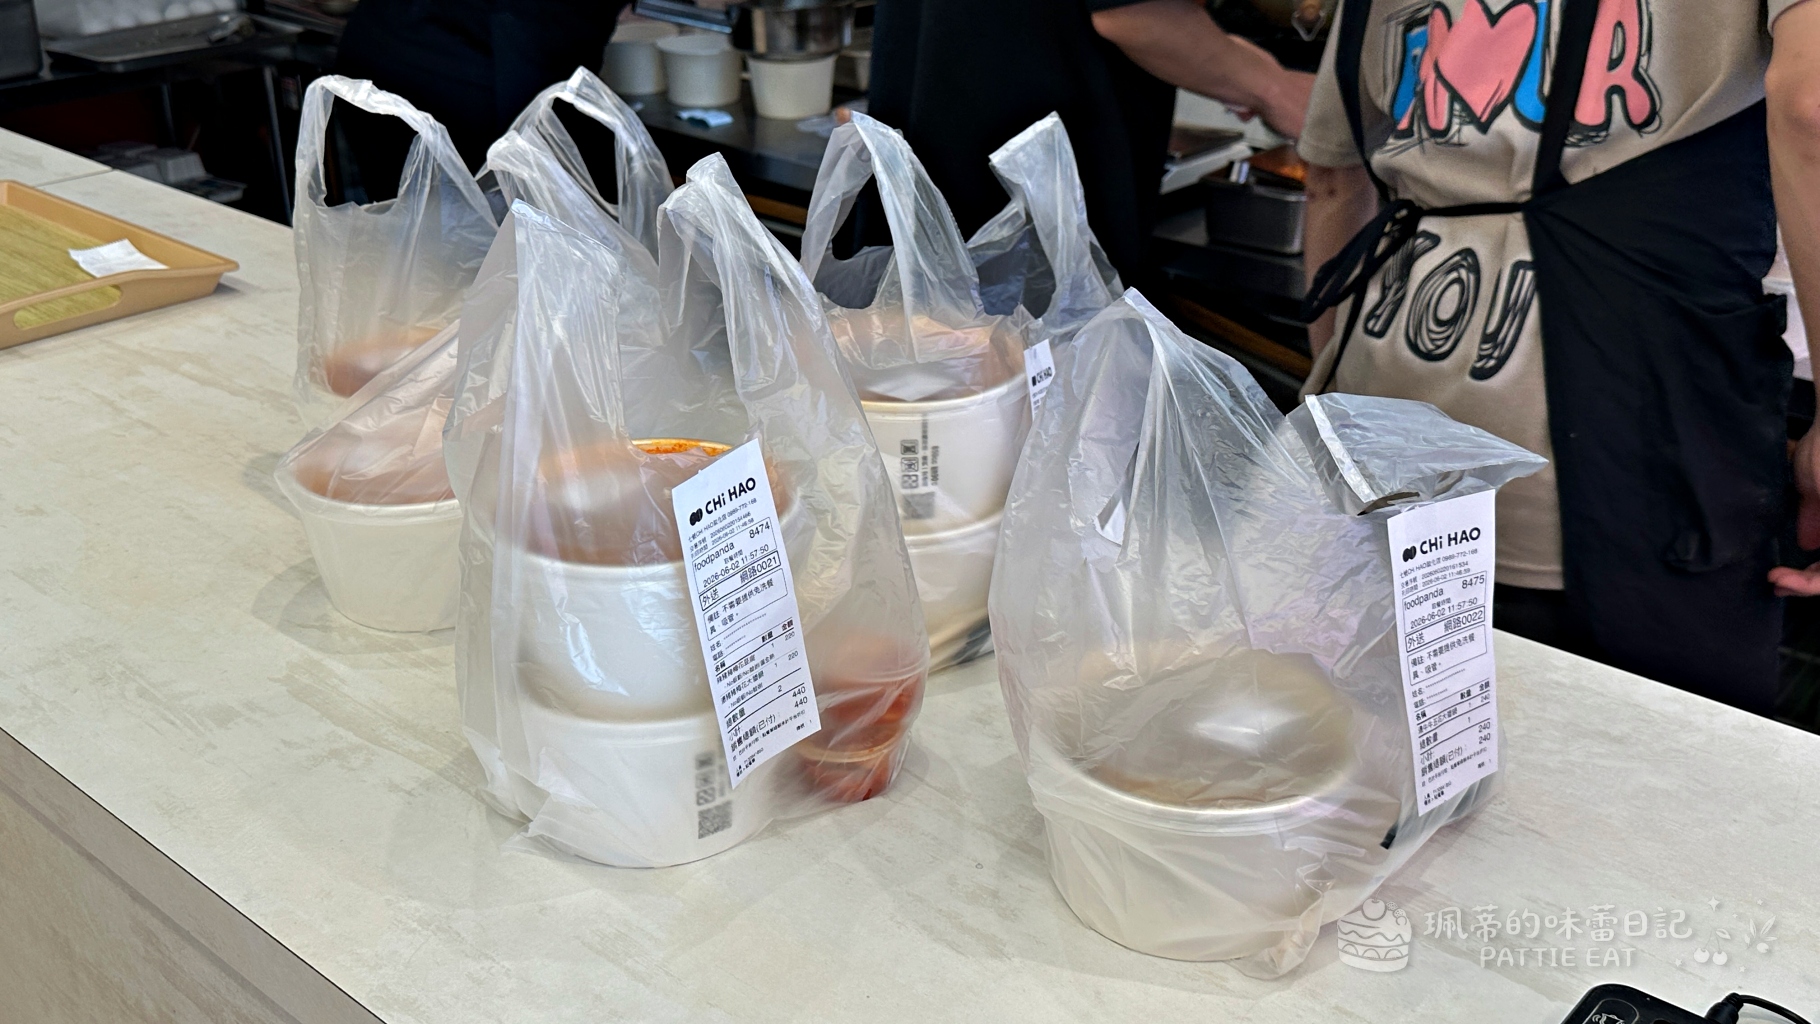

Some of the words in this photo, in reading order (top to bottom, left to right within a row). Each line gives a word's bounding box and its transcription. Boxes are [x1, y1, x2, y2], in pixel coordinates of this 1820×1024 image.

[727, 477, 756, 501] HAO
[694, 542, 734, 571] foodpanda
[748, 521, 770, 538] 8474
[1447, 526, 1480, 546] HAO
[702, 560, 739, 588] 2026-06-02
[740, 543, 769, 564] 11:57:50
[702, 587, 719, 607] 外送
[739, 556, 776, 582] 網路0021
[1403, 587, 1443, 610] foodpanda
[1461, 574, 1484, 589] 8475
[1410, 607, 1445, 629] 2026-06-02
[1447, 596, 1478, 613] 11:57:50
[784, 630, 795, 641] 220
[1407, 631, 1425, 649] 外送
[1443, 609, 1483, 632] 網路0022
[787, 650, 798, 661] 220
[792, 685, 806, 697] 440
[1480, 693, 1490, 702] 240
[794, 695, 808, 708] 440
[1478, 721, 1490, 733] 240
[1478, 732, 1491, 744] 240
